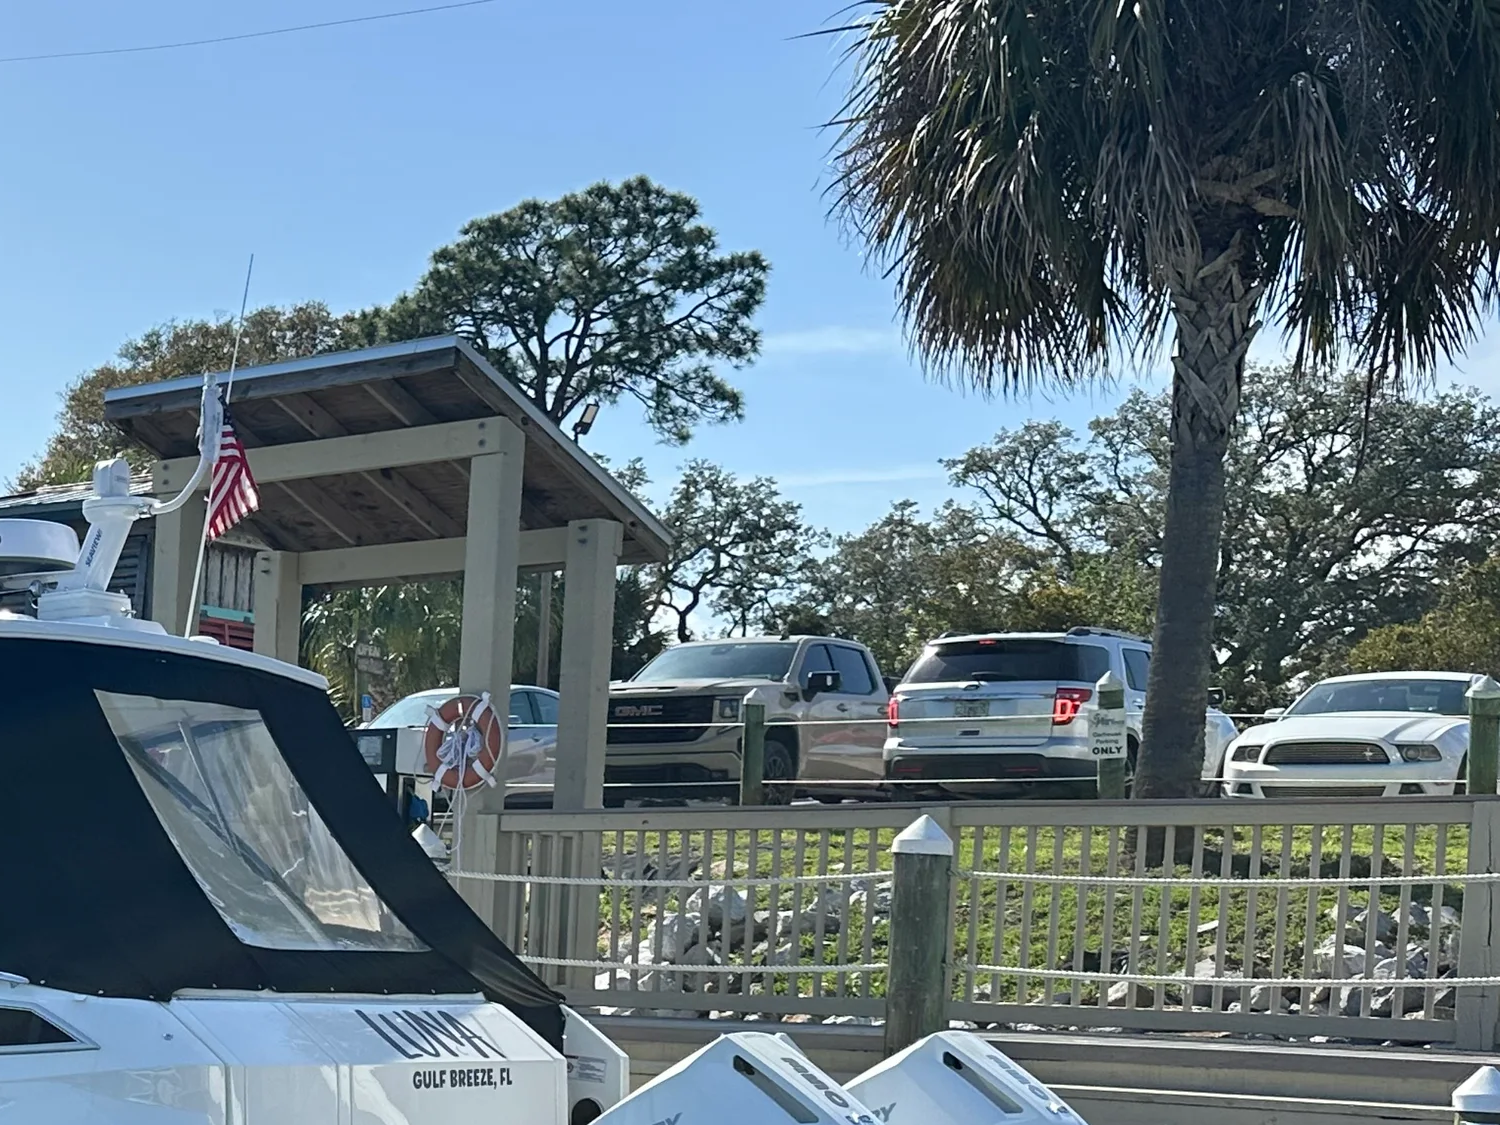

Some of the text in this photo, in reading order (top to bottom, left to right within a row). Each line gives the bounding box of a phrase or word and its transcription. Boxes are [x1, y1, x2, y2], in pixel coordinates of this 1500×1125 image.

[615, 705, 663, 717] GMC
[1092, 746, 1123, 755] ONLY
[355, 1009, 508, 1059] LUNA
[412, 1067, 513, 1089] GULF BREEZE, FL
